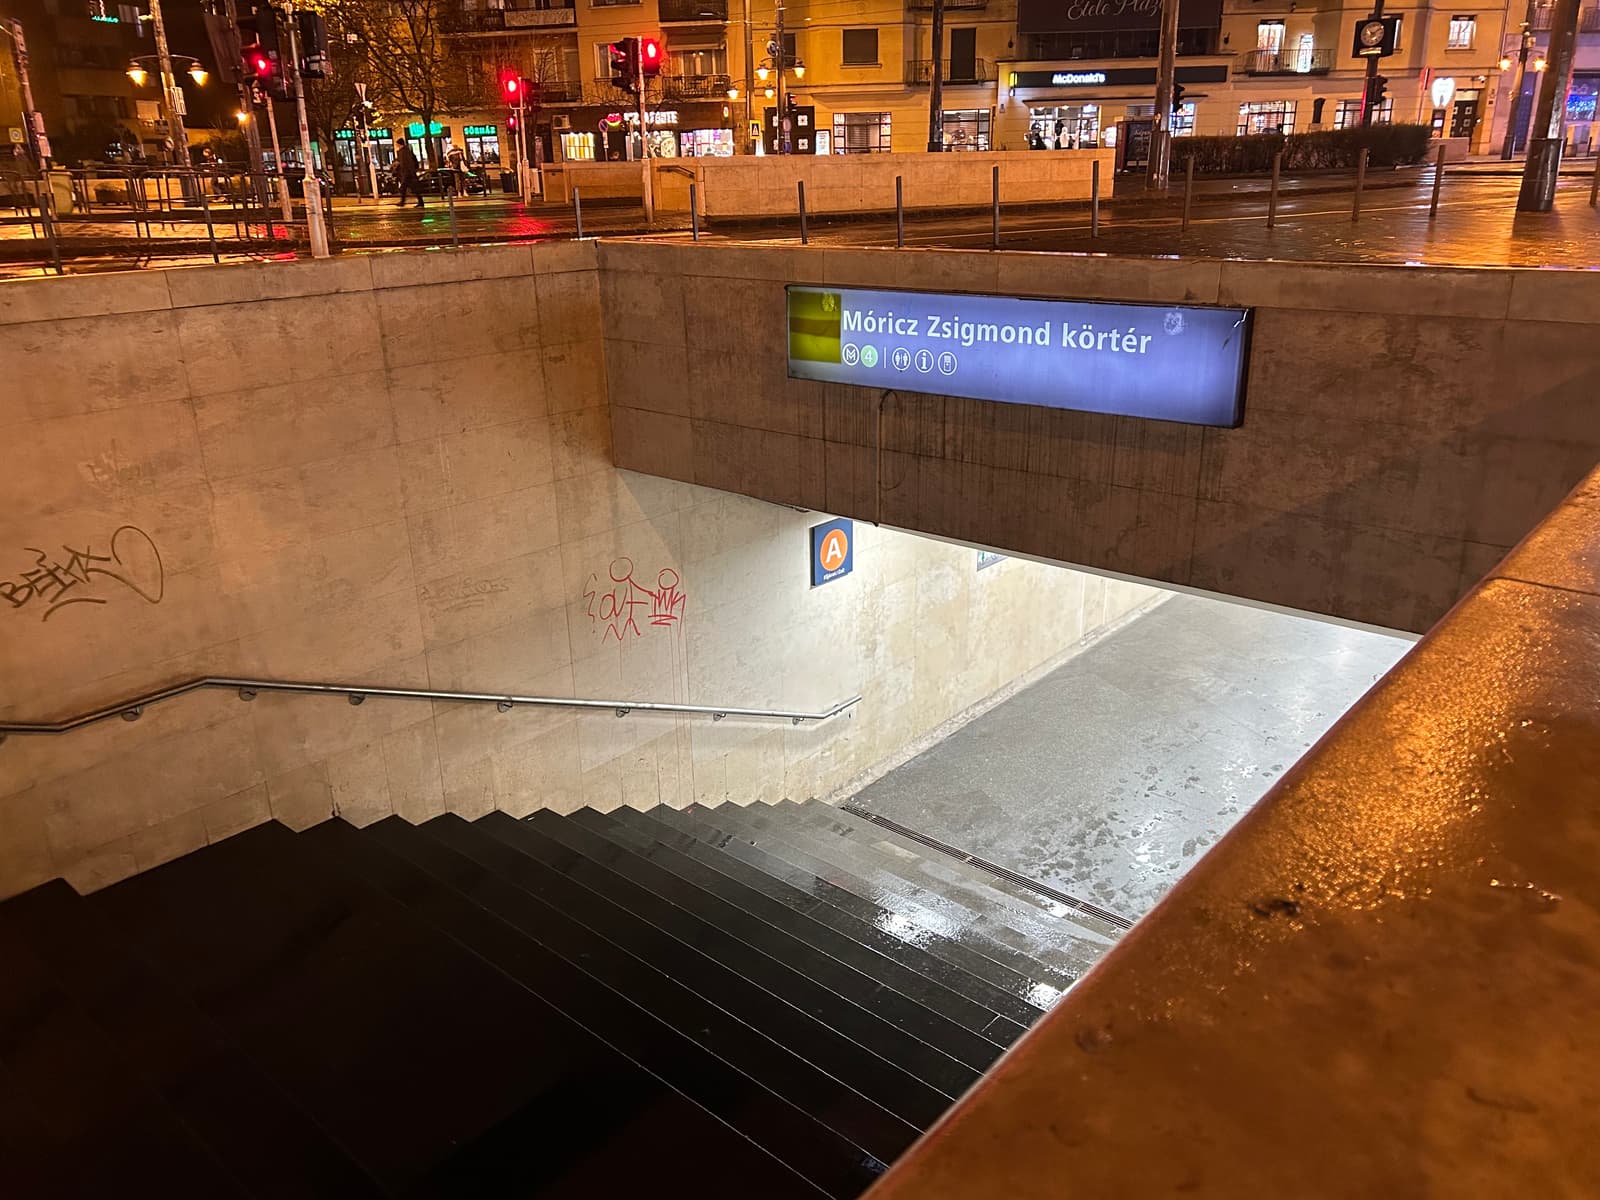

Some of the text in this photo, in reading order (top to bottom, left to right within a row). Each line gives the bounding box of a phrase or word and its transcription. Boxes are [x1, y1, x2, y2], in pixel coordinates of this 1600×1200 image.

[1113, 0, 1163, 17] Plaz
[1052, 72, 1106, 84] McDonald's
[842, 308, 1153, 355] Móricz Zsigmond körtér
[825, 536, 843, 564] A
